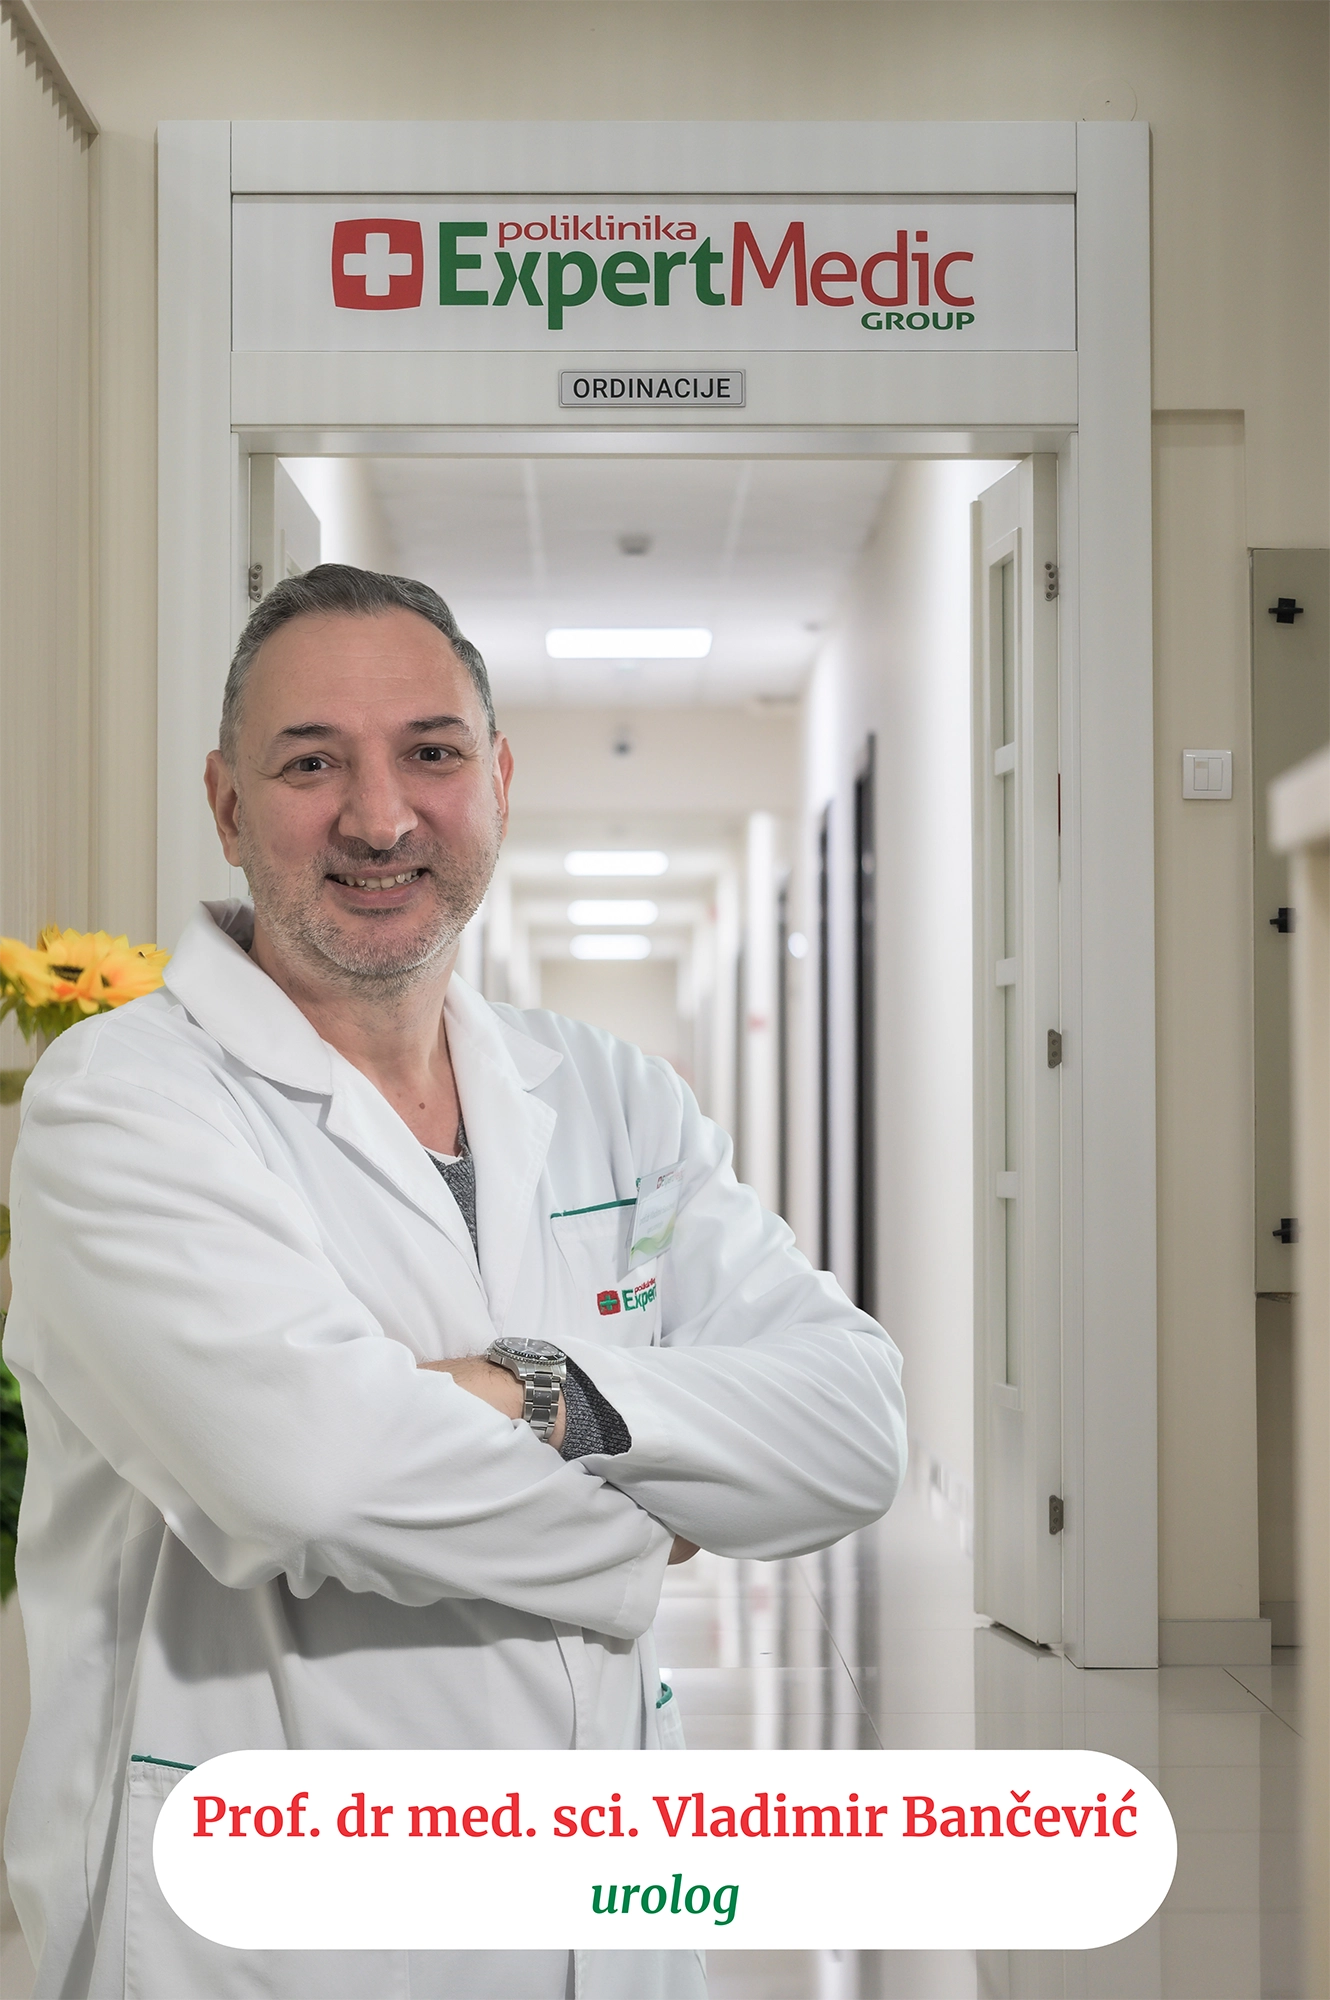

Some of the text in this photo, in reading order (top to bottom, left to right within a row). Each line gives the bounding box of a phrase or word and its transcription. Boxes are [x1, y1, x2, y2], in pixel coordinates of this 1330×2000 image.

[498, 215, 698, 248] poliklinika
[861, 311, 975, 331] GROUP
[573, 377, 731, 399] ORDINACIJE
